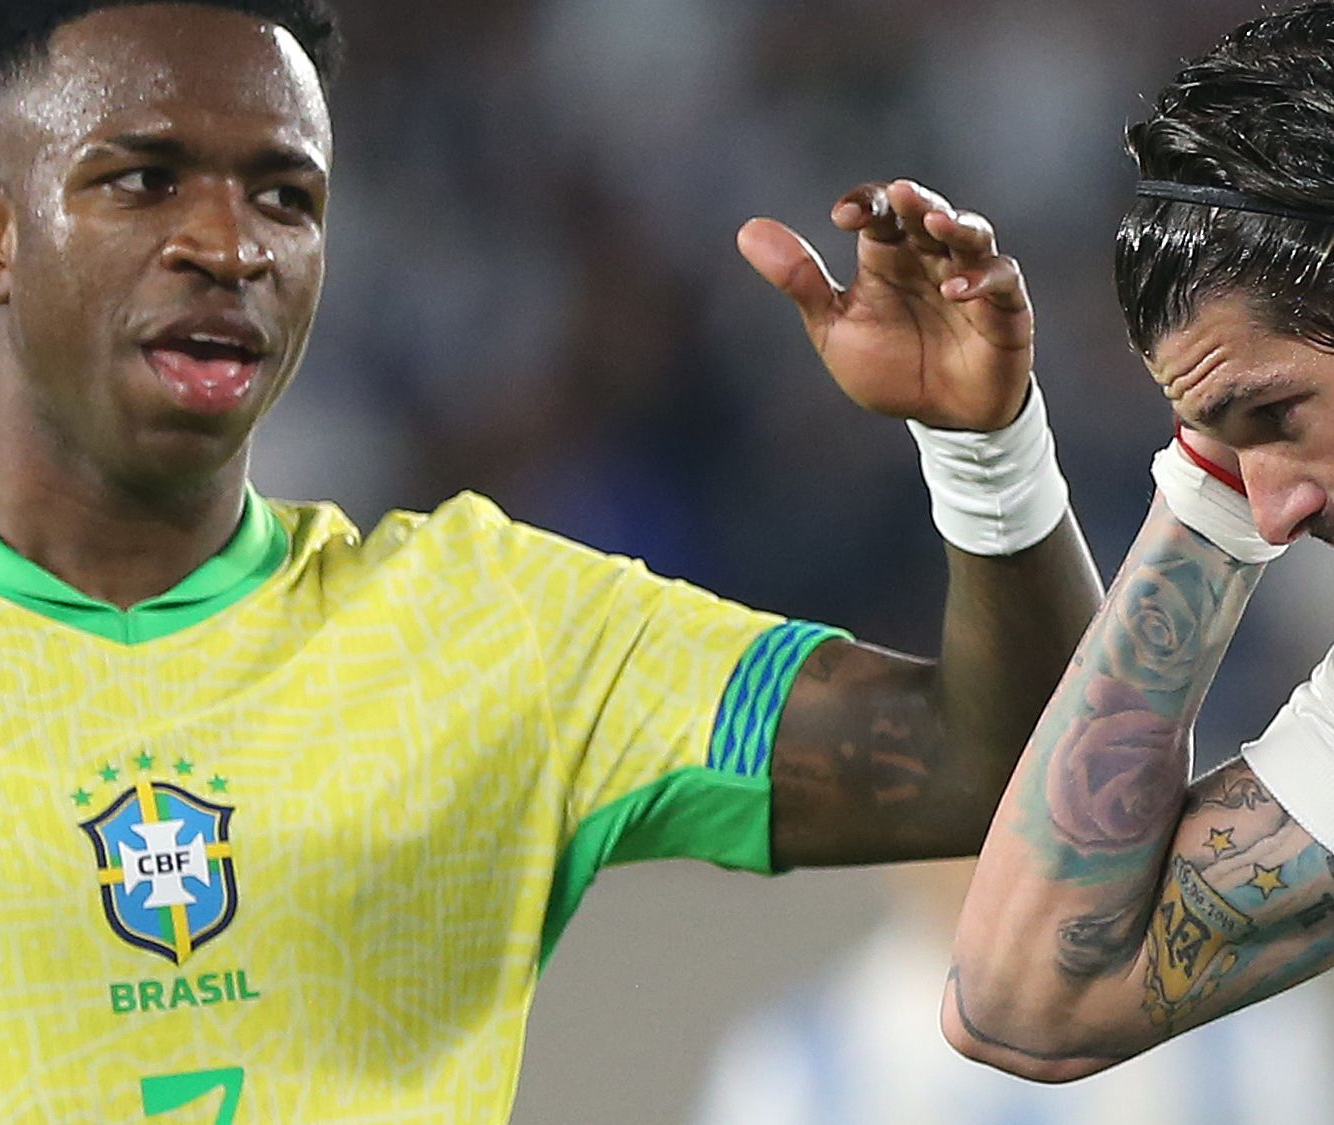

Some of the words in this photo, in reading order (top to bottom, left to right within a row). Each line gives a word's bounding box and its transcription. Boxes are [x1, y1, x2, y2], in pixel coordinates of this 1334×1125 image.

[138, 850, 192, 876] CBF
[1160, 901, 1212, 978] AFA
[109, 970, 261, 1014] BRASIL
